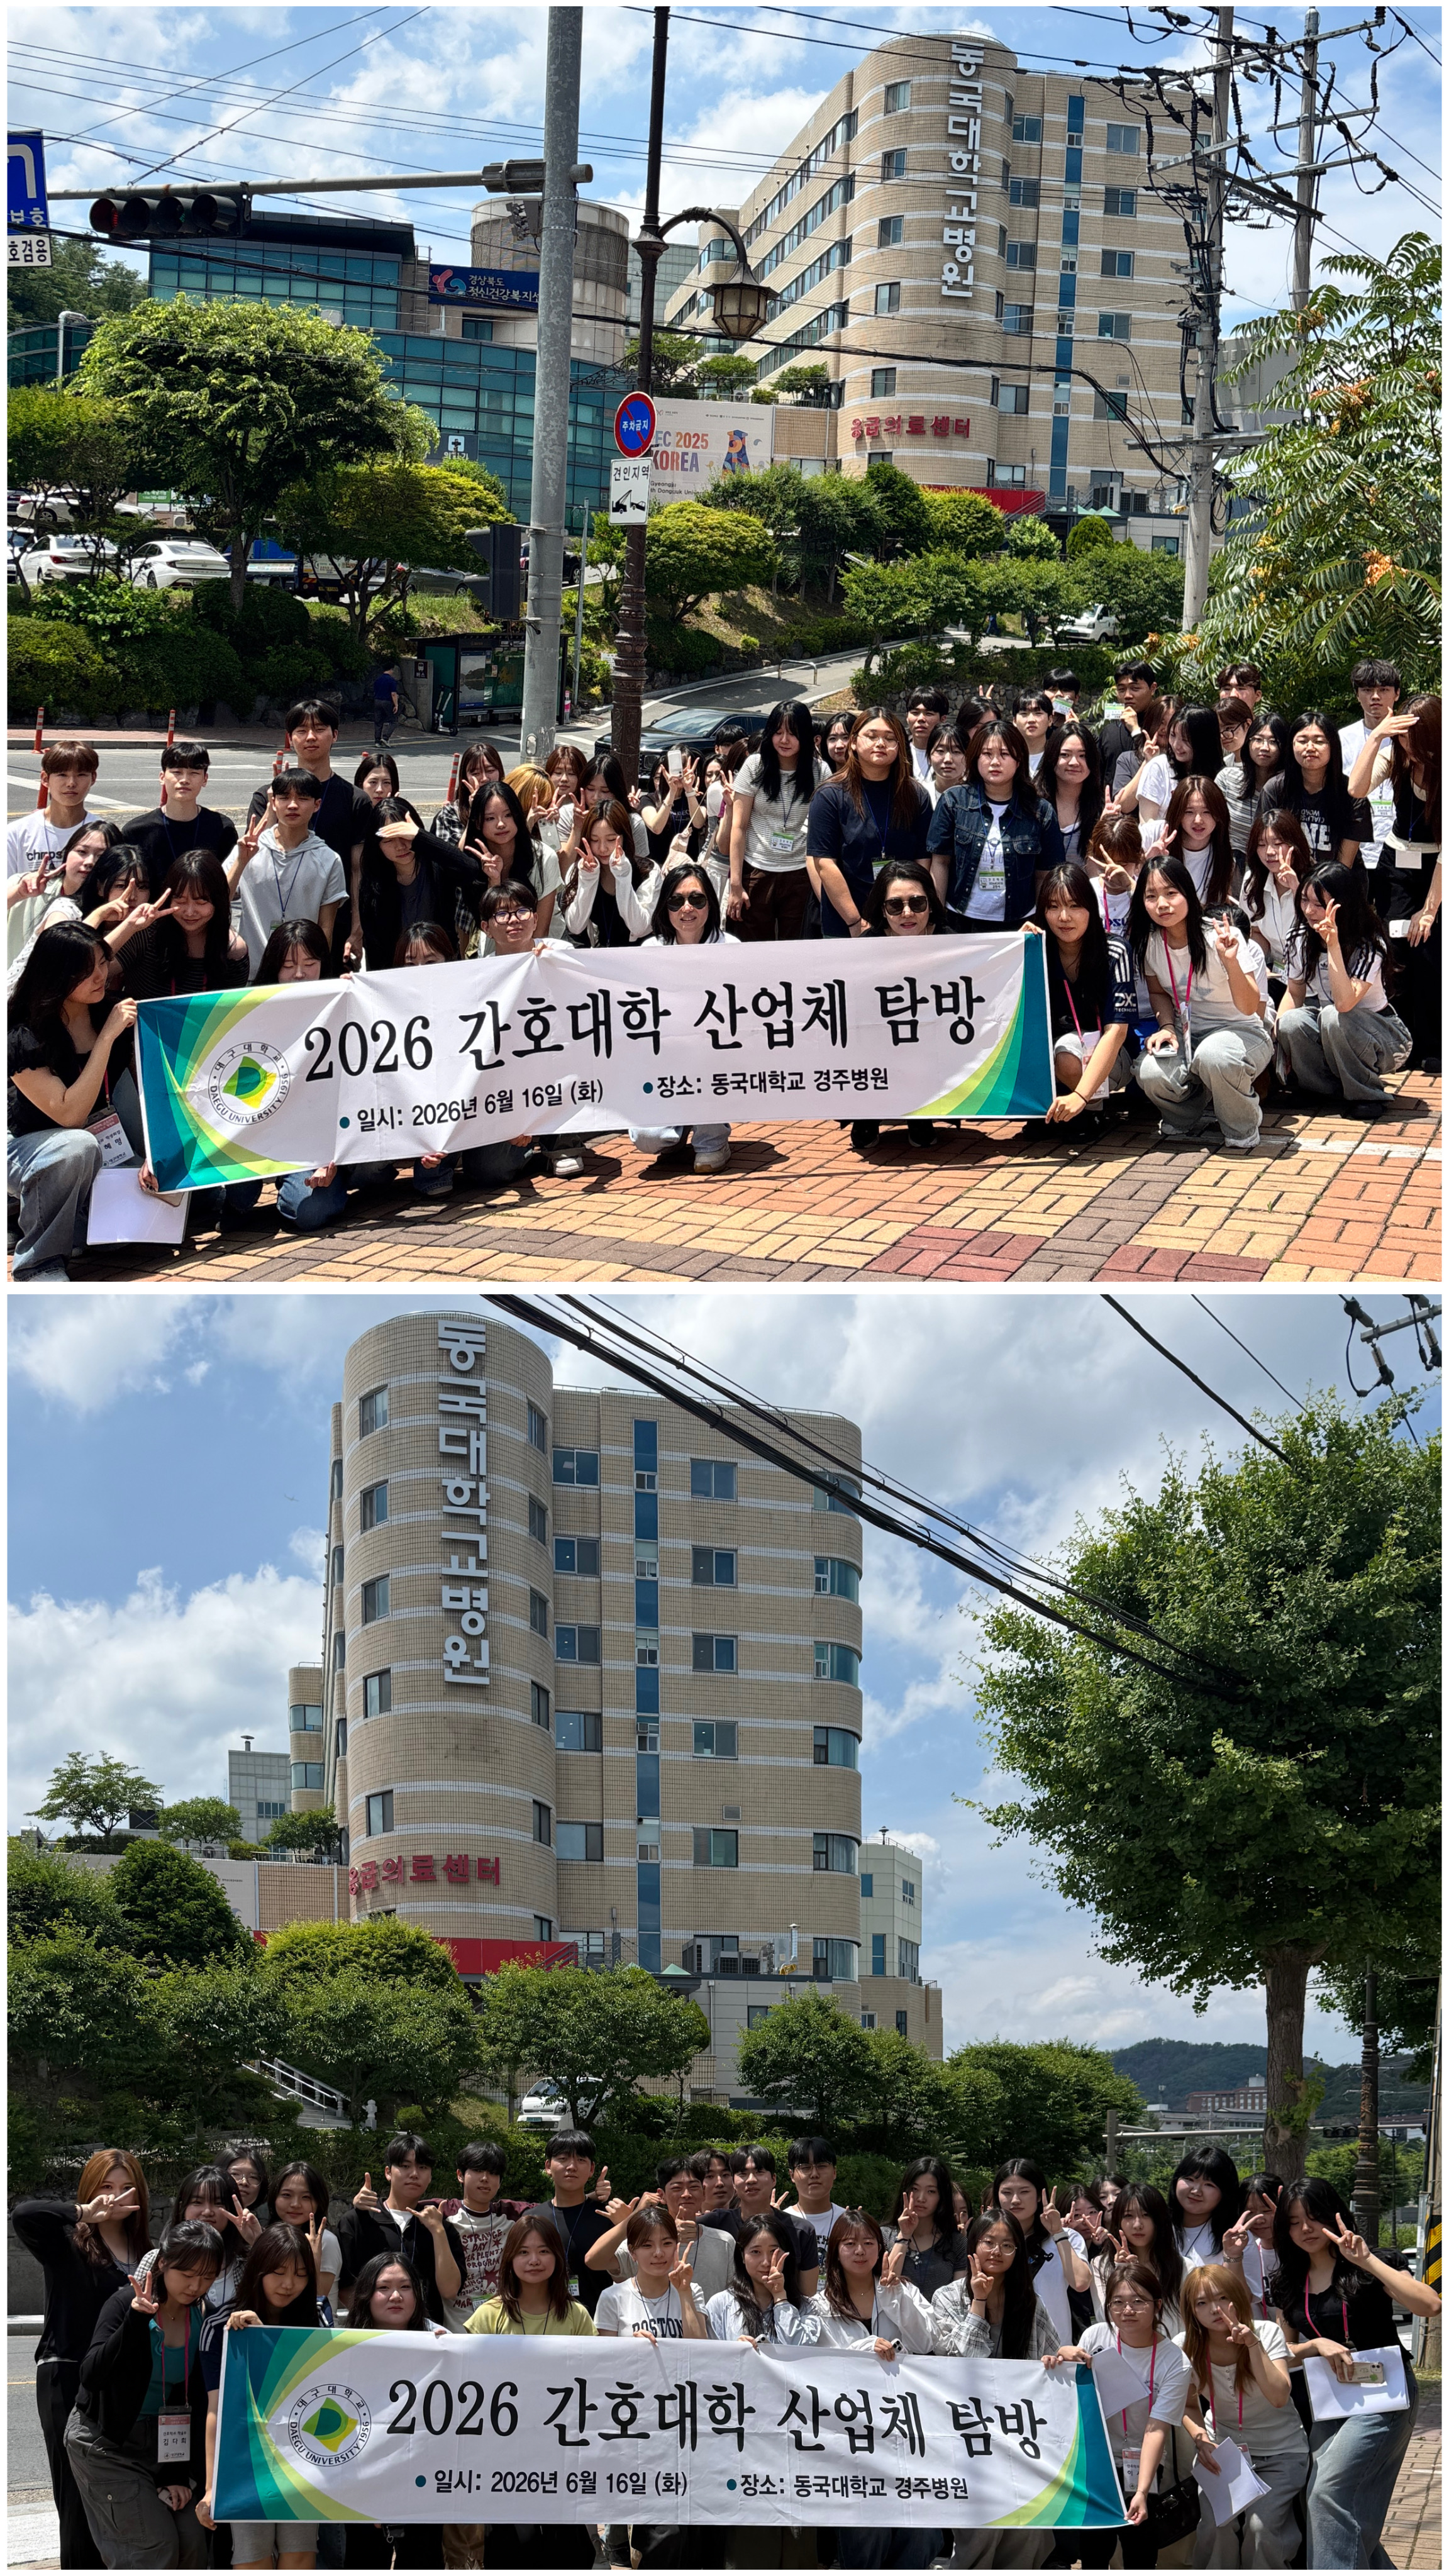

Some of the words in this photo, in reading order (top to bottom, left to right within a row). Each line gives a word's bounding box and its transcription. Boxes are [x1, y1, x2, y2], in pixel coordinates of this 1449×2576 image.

[941, 42, 985, 298] 동국대학교병원
[8, 240, 48, 262] 호겸용
[469, 275, 504, 286] 경상북도
[622, 419, 648, 432] 주차금지
[850, 414, 970, 438] 응급의료센터
[655, 430, 672, 447] EC
[675, 431, 709, 450] 2025
[613, 465, 649, 482] 견인지역
[652, 450, 699, 472] KOREA
[304, 1015, 433, 1082] 2026
[458, 986, 672, 1071] 간호대학
[694, 979, 848, 1050] 산업체
[875, 975, 985, 1046] 탐방
[214, 1043, 282, 1071] 대구대학교
[657, 1075, 702, 1097] 장소:
[711, 1070, 806, 1096] 동국대학교
[813, 1067, 889, 1092] 경주병원
[210, 1085, 228, 1116] DAEGU
[229, 1097, 282, 1123] UNIVERSITY
[279, 1073, 289, 1095] 1956
[357, 1106, 403, 1132] 일시:
[412, 1096, 478, 1126] 2026년
[484, 1089, 514, 1114] 6월
[522, 1084, 563, 1108] 16일
[570, 1079, 604, 1105] (화)
[438, 1320, 490, 1685] 동국대학교병원
[348, 1854, 500, 1896] 응급의료센터
[472, 2241, 488, 2252] DAY
[297, 2385, 365, 2409] 대구대학교
[386, 2379, 519, 2437] 2026
[543, 2377, 757, 2453] 간호대학
[777, 2385, 926, 2458] 산업체
[945, 2397, 1048, 2460] 탐방
[290, 2421, 306, 2453] DAEGU
[305, 2443, 360, 2465] UNIVERSITY
[358, 2421, 370, 2443] 1956
[434, 2469, 482, 2494] 일시:
[491, 2470, 558, 2495] 2026년
[565, 2470, 597, 2495] 6월
[606, 2472, 647, 2495] 16일
[653, 2472, 688, 2497] (화)
[740, 2474, 785, 2497] 장소:
[794, 2475, 887, 2498] 동국대학교
[894, 2476, 969, 2500] 경주병원
